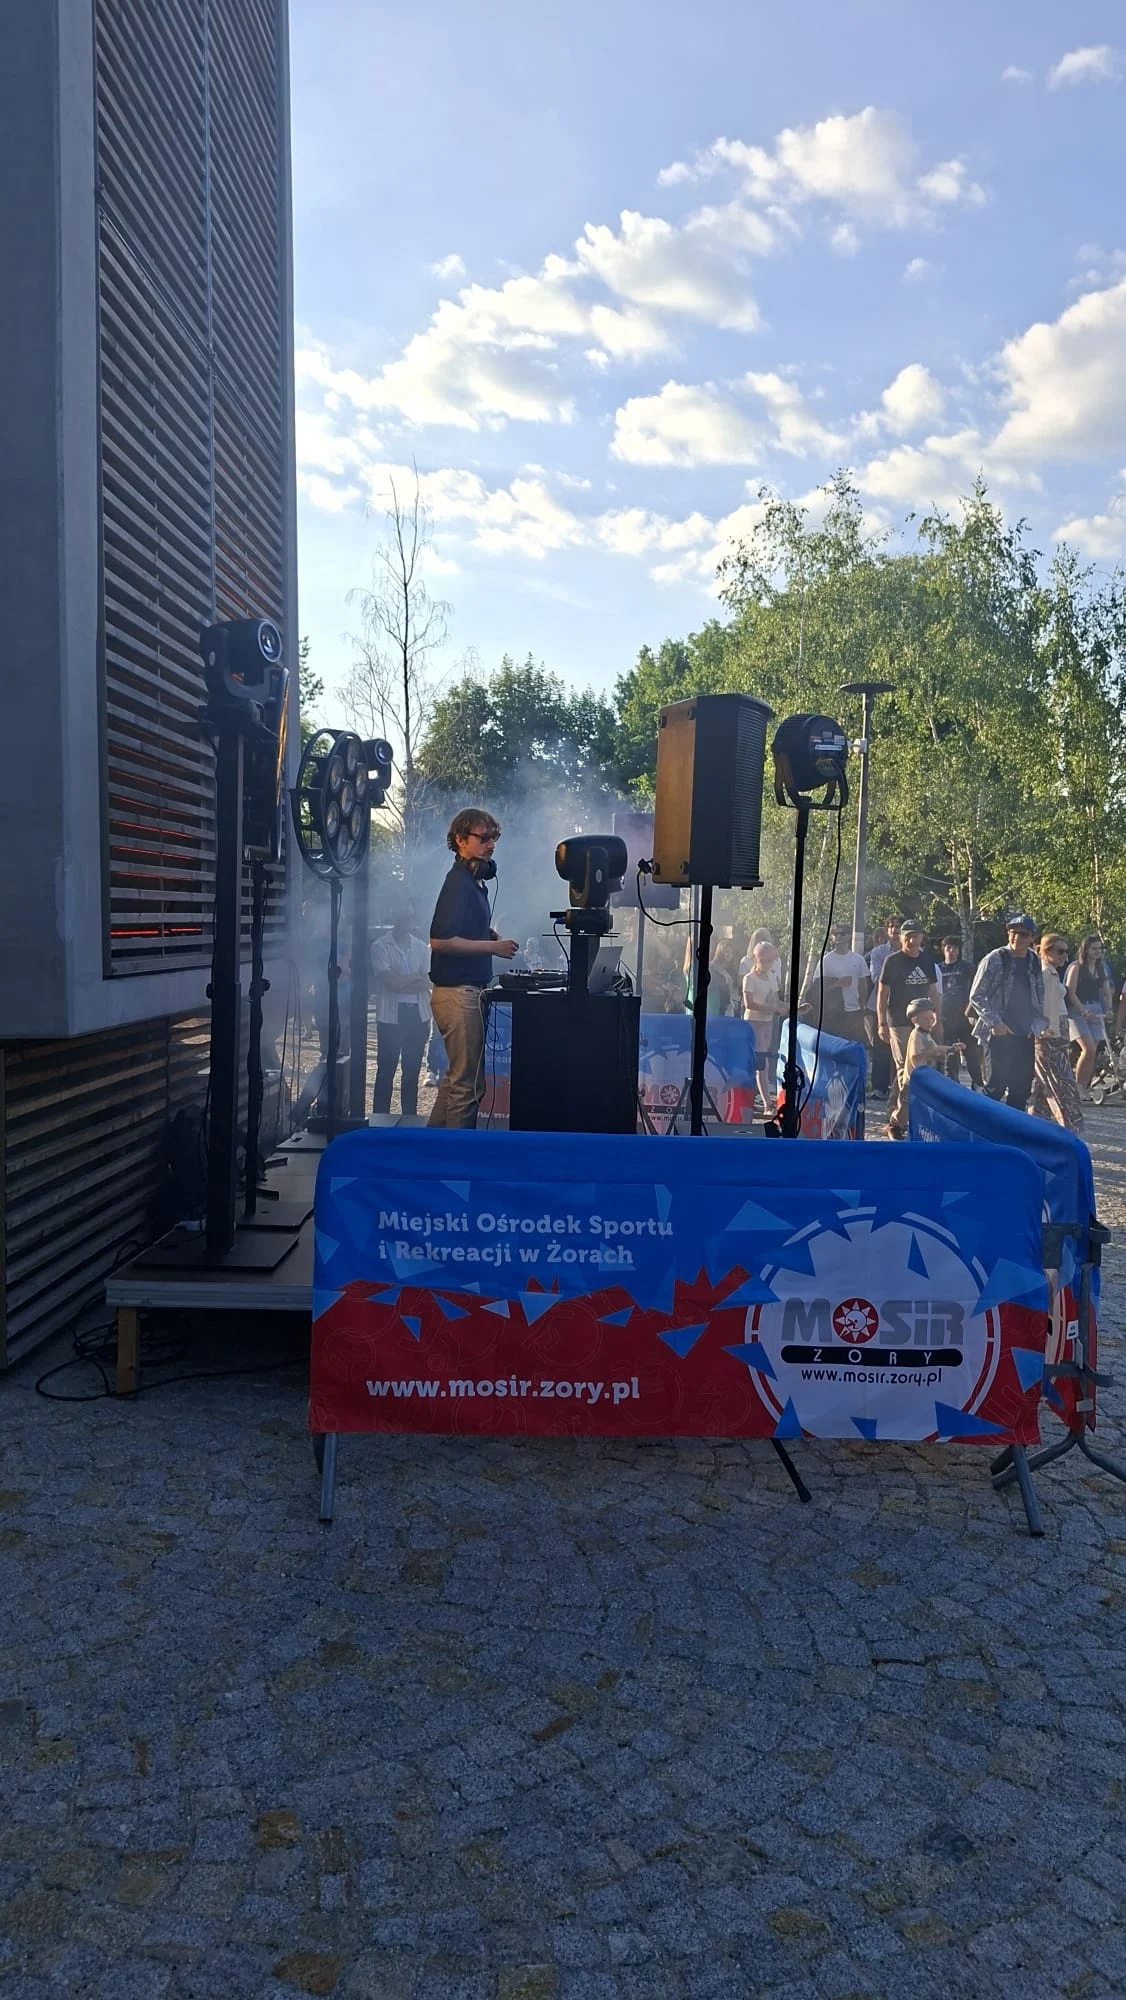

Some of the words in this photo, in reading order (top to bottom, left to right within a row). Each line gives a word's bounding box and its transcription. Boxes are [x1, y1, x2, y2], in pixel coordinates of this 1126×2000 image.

[378, 1210, 469, 1234] Miejski
[476, 1211, 582, 1235] Ośrodek
[589, 1215, 673, 1239] Sportu
[379, 1242, 387, 1260] i
[395, 1241, 511, 1264] Rekreacji
[519, 1247, 539, 1263] w
[546, 1240, 634, 1264] Żorach
[366, 1375, 640, 1404] www.mosir.zory.pl
[801, 1368, 942, 1387] www.mosir.zory.pl
